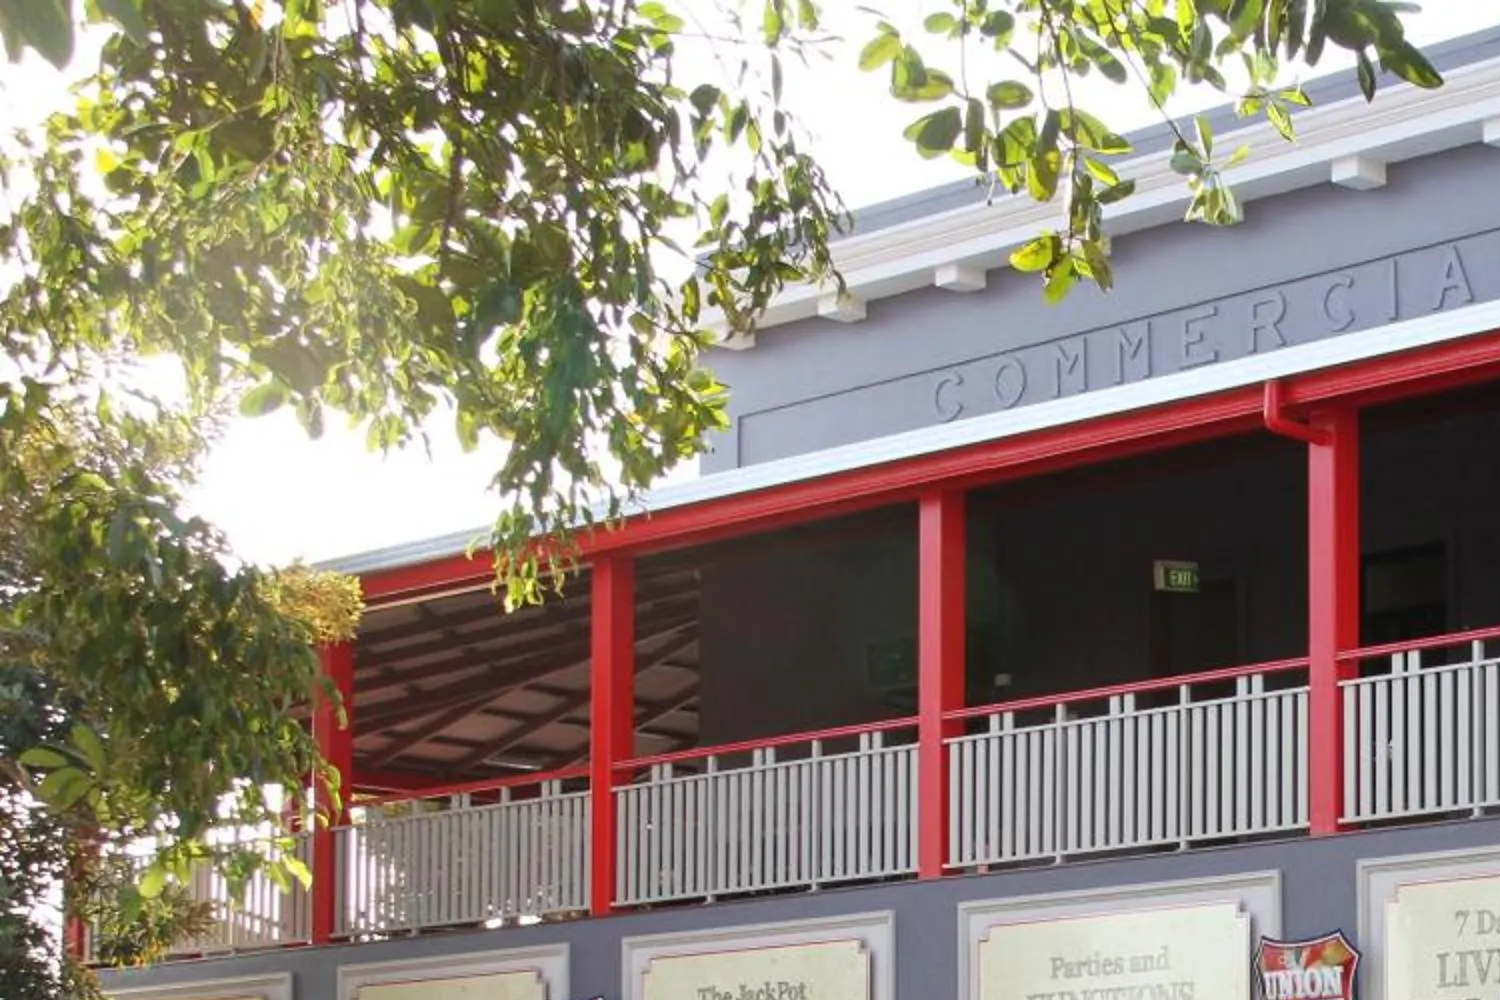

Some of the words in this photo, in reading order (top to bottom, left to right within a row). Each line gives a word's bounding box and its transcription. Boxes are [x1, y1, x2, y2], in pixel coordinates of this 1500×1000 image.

[1455, 910, 1470, 933] 7
[1049, 955, 1123, 980] Parties
[1129, 947, 1171, 973] and
[1264, 965, 1344, 1000] UNION
